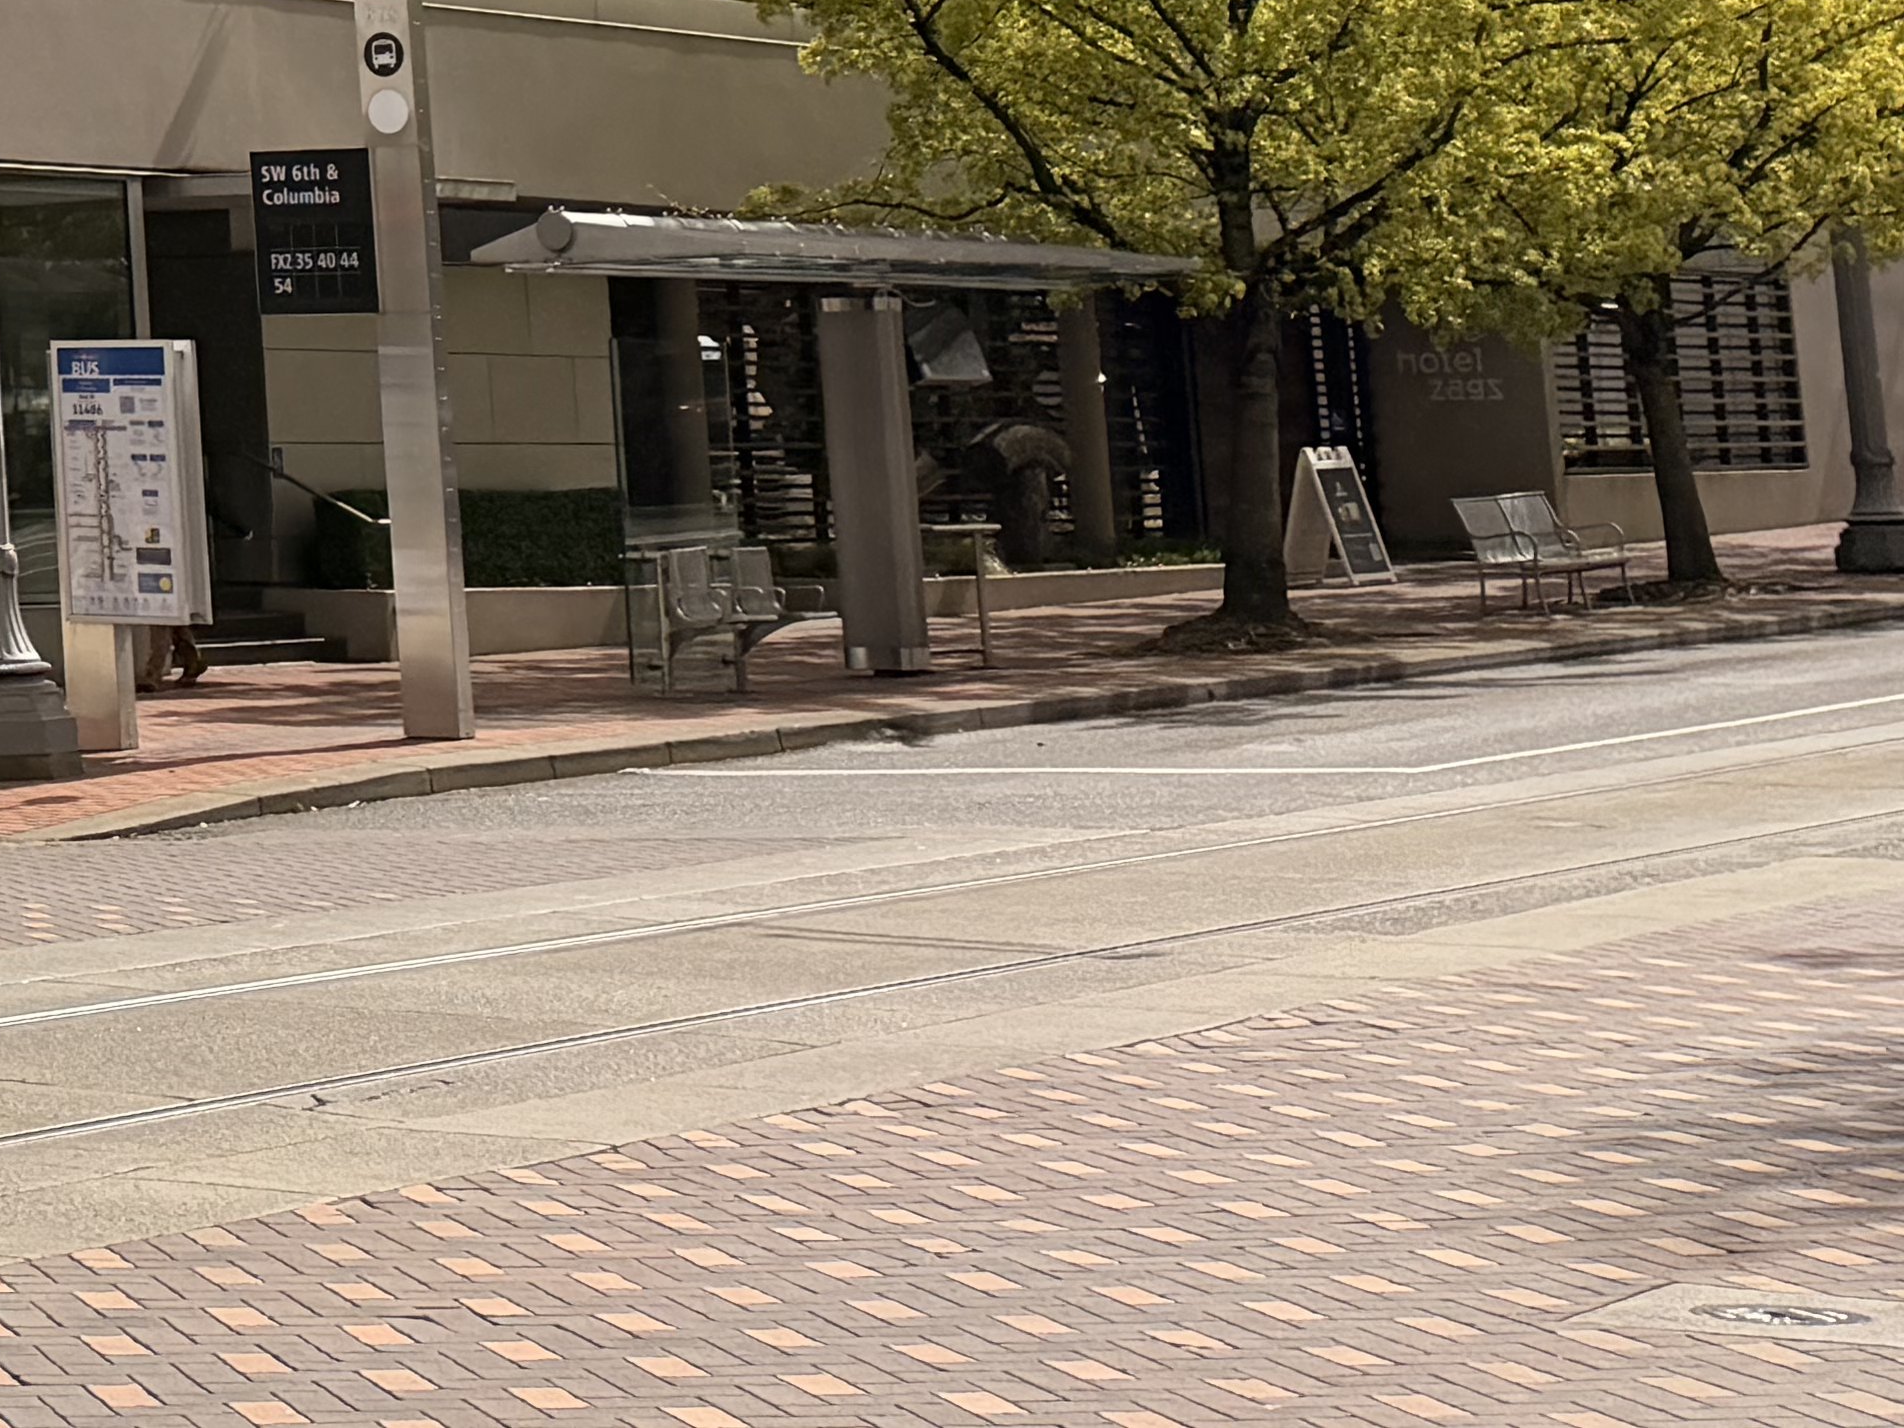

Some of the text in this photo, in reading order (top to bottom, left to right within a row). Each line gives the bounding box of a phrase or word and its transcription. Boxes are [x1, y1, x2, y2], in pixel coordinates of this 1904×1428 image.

[261, 163, 339, 183] SW 6th &
[262, 186, 341, 206] Columbia
[295, 253, 313, 270] 35
[317, 252, 336, 269] 40
[340, 251, 359, 269] 44
[274, 277, 292, 294] 54
[71, 360, 100, 376] BUS
